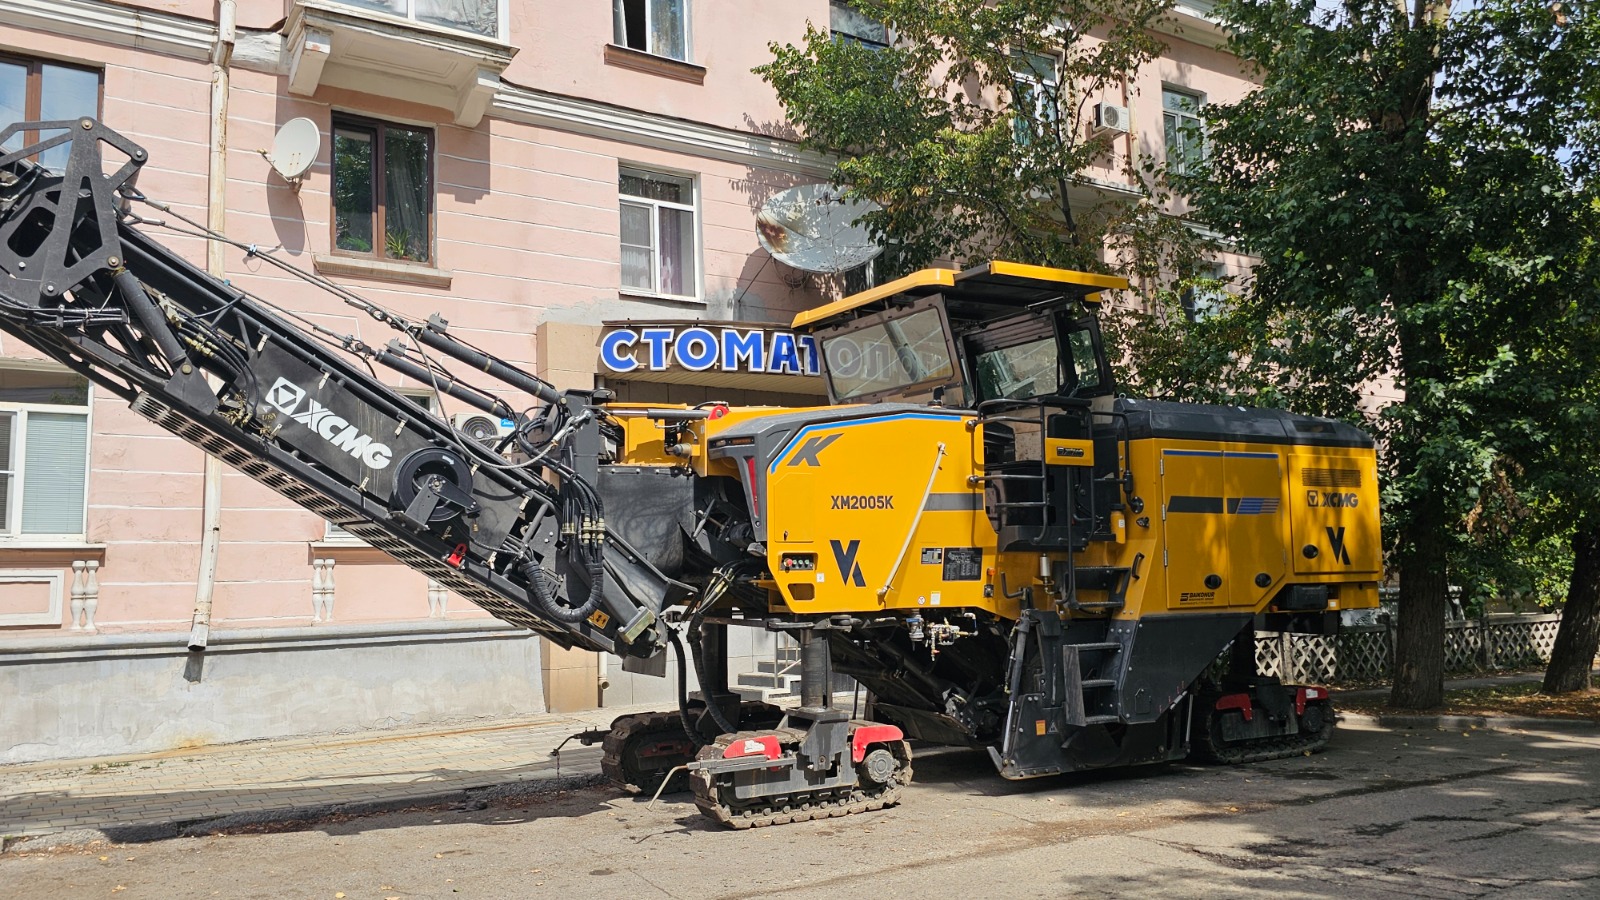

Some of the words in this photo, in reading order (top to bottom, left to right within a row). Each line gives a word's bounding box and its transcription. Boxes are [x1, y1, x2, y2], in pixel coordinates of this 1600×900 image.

[290, 398, 393, 469] XCMG
[831, 495, 894, 510] XM2005K
[1320, 492, 1358, 508] XCMG
